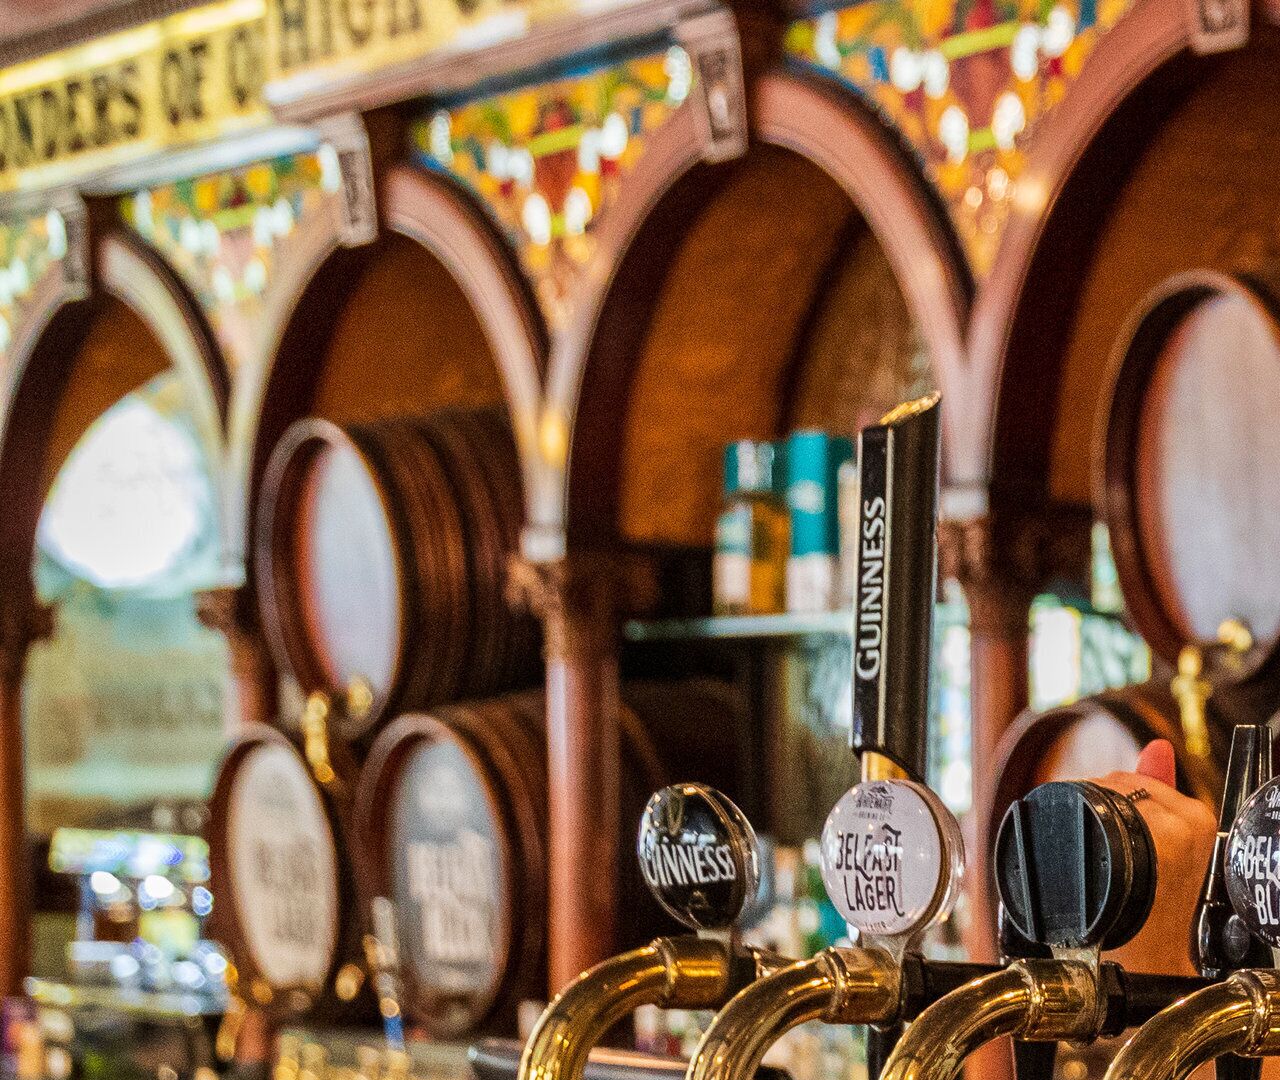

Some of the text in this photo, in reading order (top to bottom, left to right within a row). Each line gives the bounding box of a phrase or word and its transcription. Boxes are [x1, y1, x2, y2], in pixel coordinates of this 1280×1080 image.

[0, 62, 144, 173] NDERS
[855, 496, 886, 682] GUINNESS
[641, 842, 736, 887] UINNESS
[836, 823, 903, 882] BELFAST
[844, 875, 906, 918] LAGER
